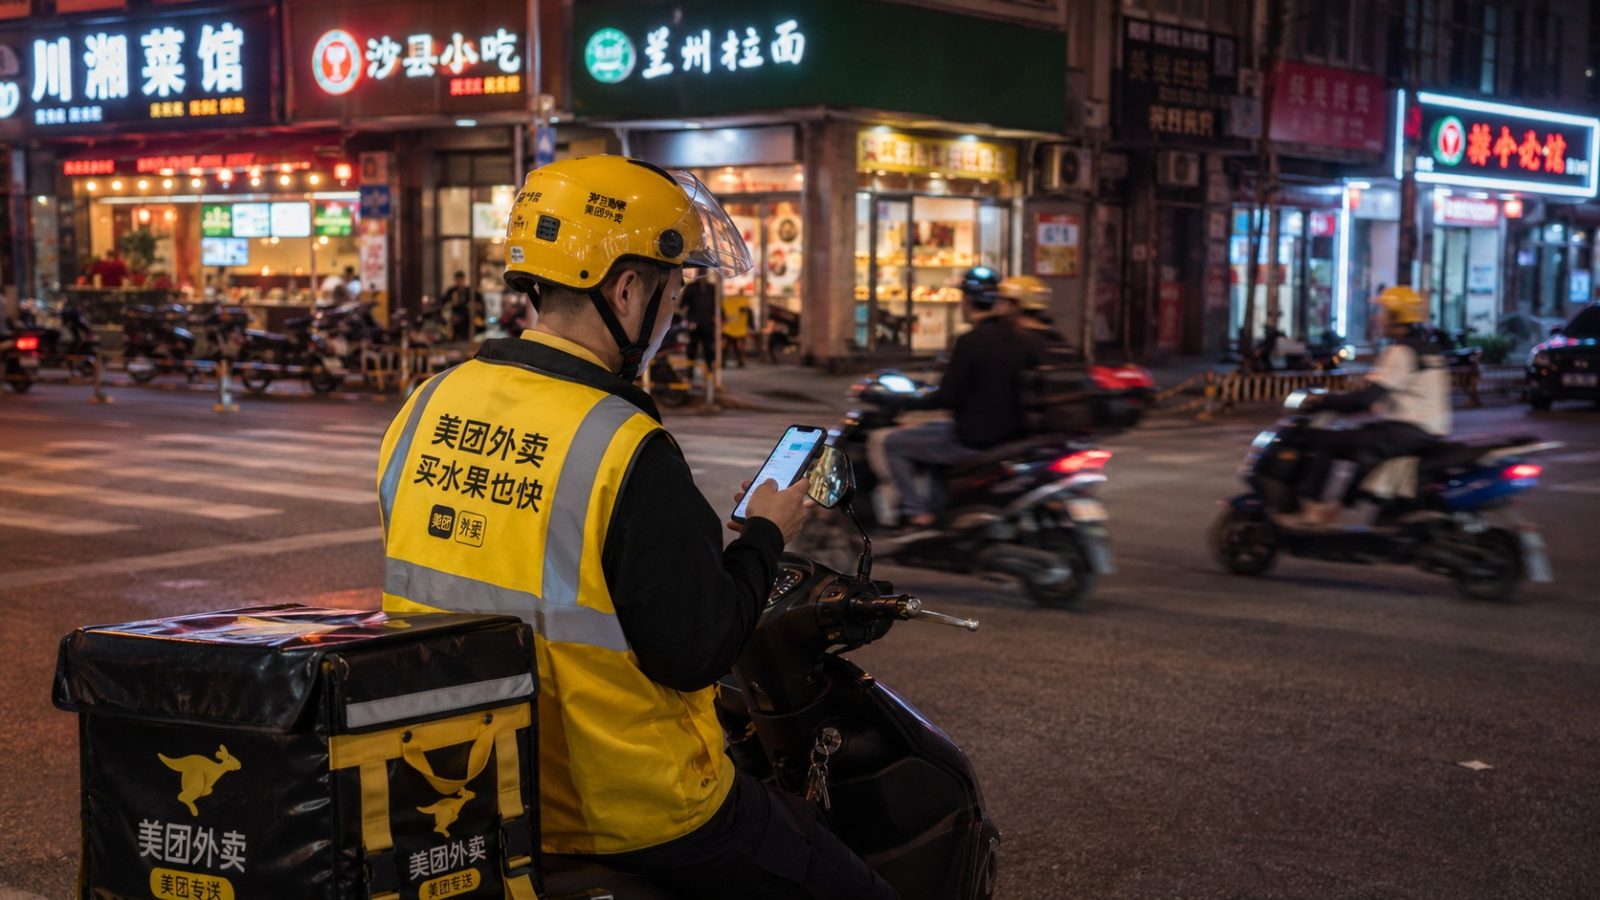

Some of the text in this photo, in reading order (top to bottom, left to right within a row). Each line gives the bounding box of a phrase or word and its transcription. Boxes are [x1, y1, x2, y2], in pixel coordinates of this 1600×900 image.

[32, 22, 246, 103] 川湘菜馆
[365, 27, 522, 80] 沙县小吃
[431, 413, 549, 469] 美团外卖
[413, 454, 544, 513] 买水果也快
[430, 512, 453, 531] 美团
[138, 818, 247, 873] 美团外卖
[409, 835, 486, 880] 美团外卖
[160, 873, 221, 900] 美团专送
[428, 871, 474, 899] 美团专送
